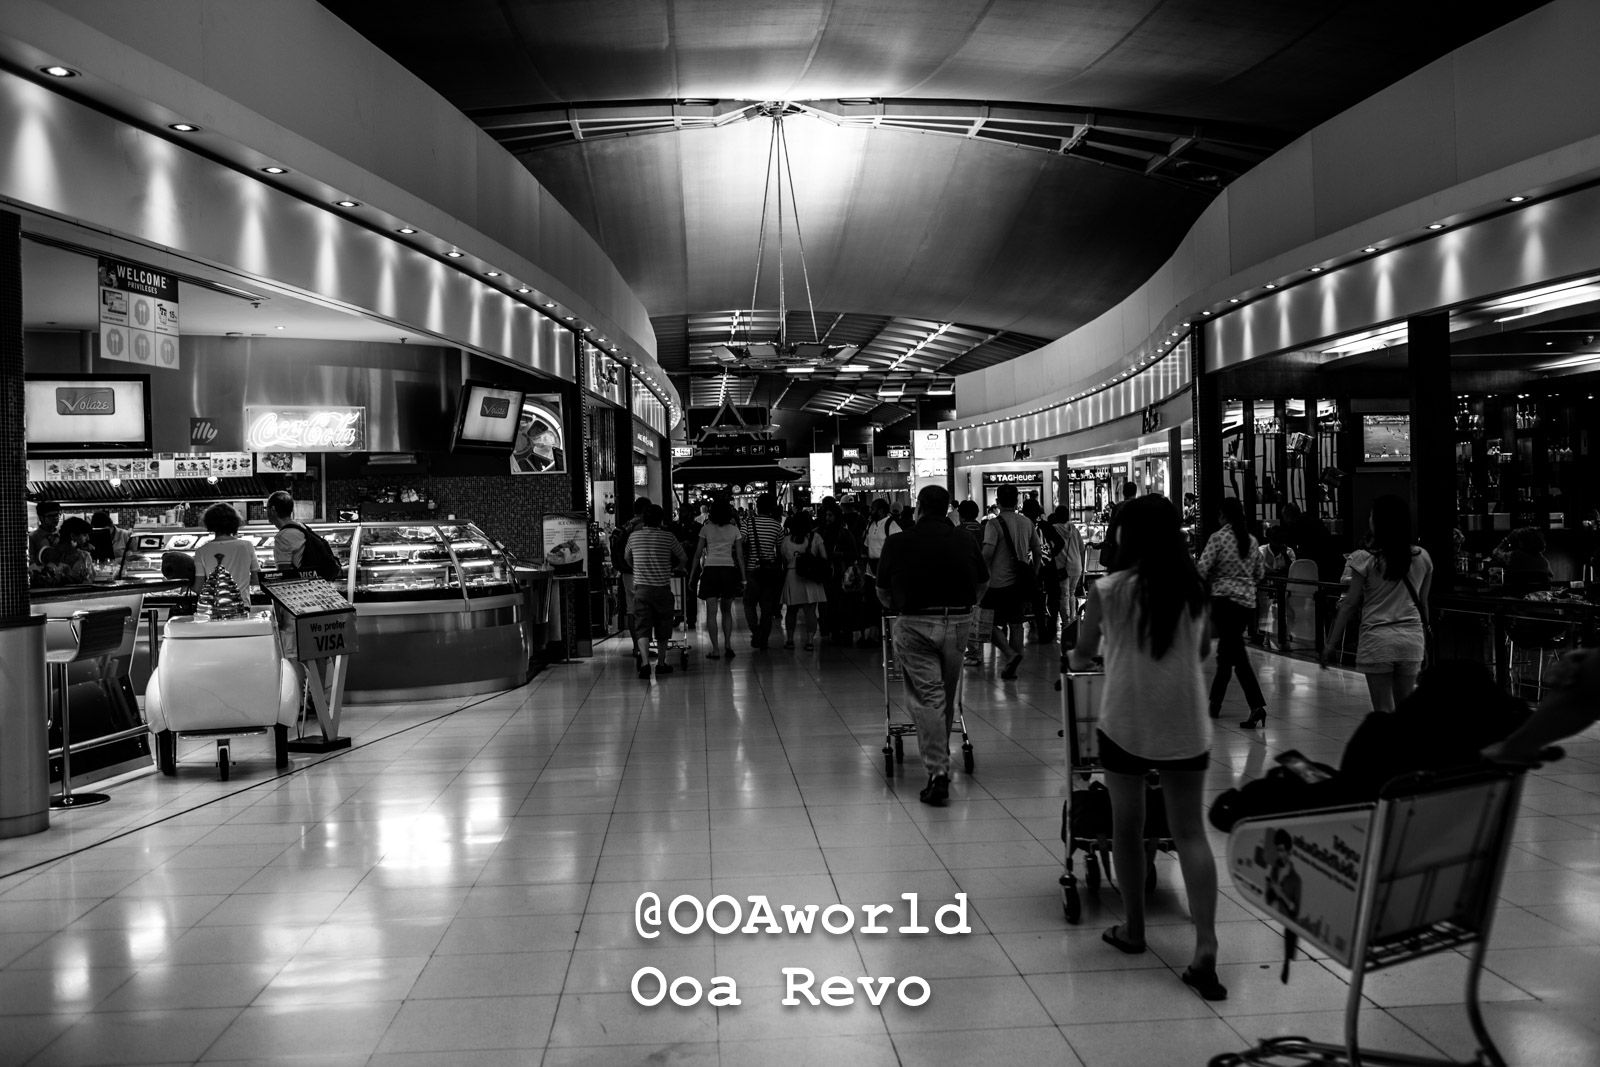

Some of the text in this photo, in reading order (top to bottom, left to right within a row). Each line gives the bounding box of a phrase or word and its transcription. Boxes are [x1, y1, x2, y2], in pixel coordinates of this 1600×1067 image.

[117, 264, 167, 289] WELCOME
[128, 281, 158, 294] PRIVILEGES
[192, 421, 218, 444] illy
[299, 570, 319, 579] VISA
[310, 620, 346, 632] We prefer
[313, 633, 345, 652] VISA
